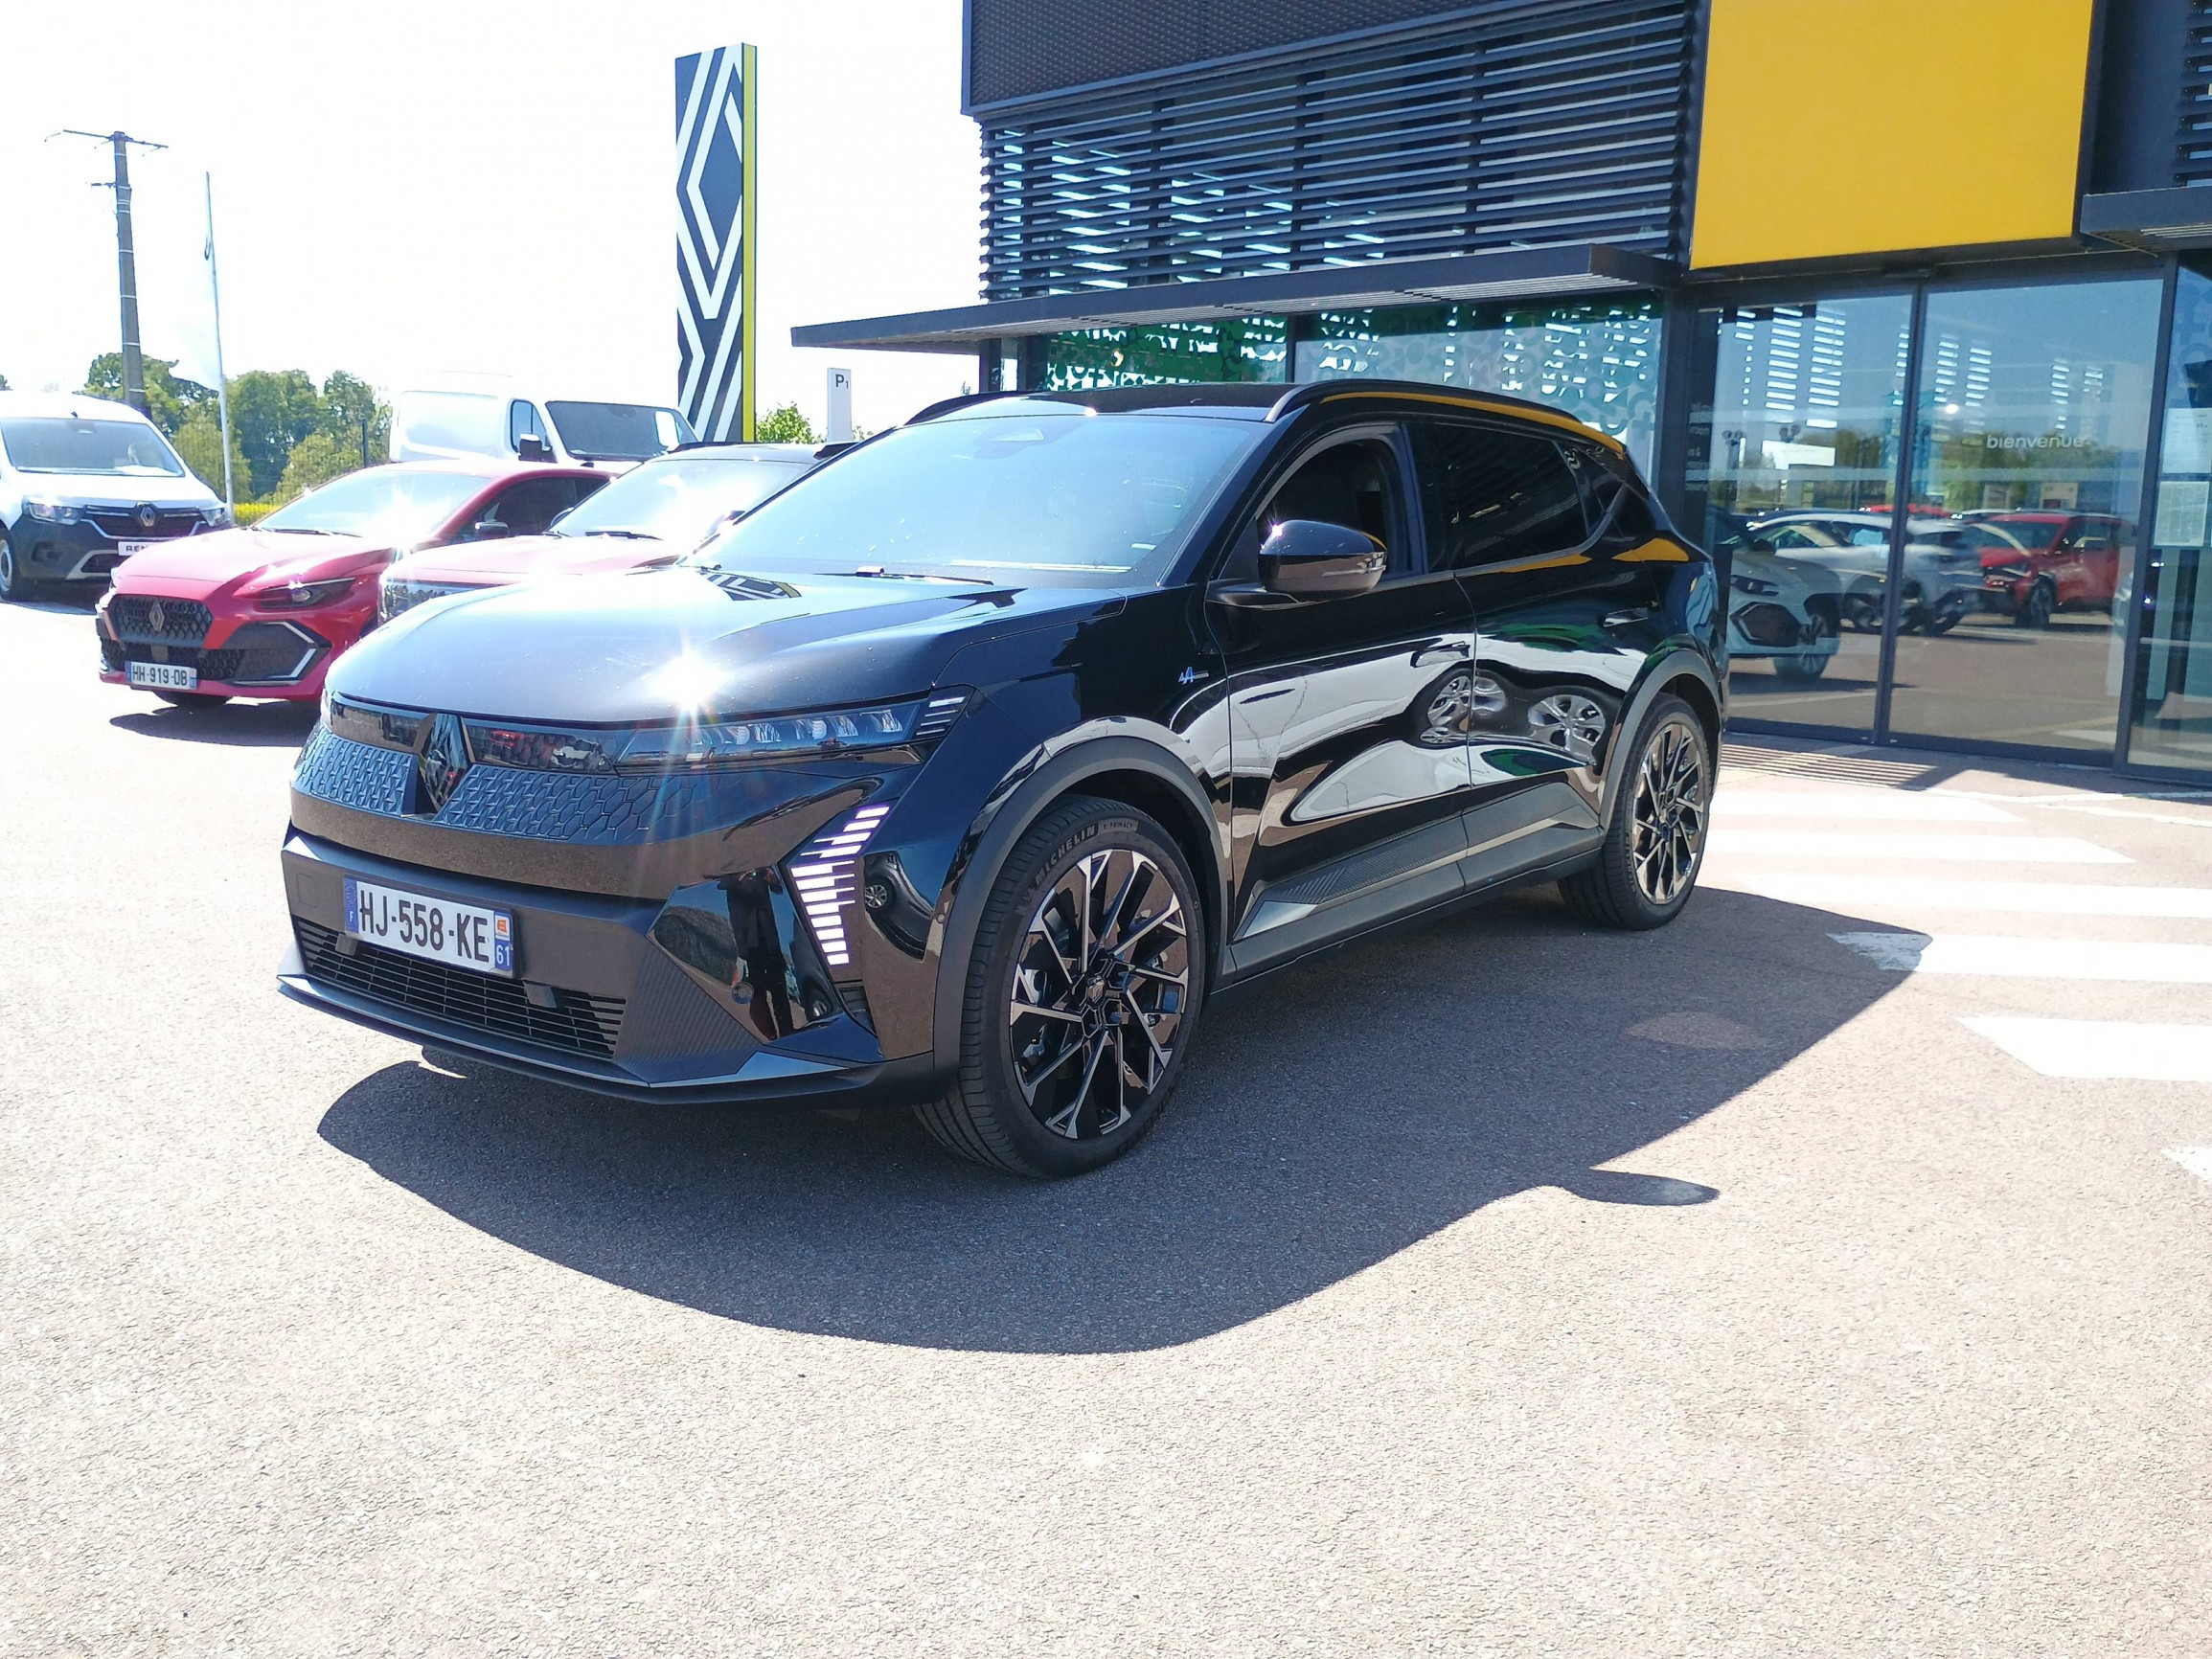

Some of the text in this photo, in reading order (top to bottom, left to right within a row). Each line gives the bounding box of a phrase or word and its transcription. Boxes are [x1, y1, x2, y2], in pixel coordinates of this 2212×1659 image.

[835, 374, 849, 389] P1
[1987, 434, 2086, 449] bienvenue
[132, 665, 188, 687] HH-919-DB
[1035, 825, 1096, 886] MICHELIN
[359, 889, 490, 964] HJ-558-KE
[496, 944, 511, 966] 61
